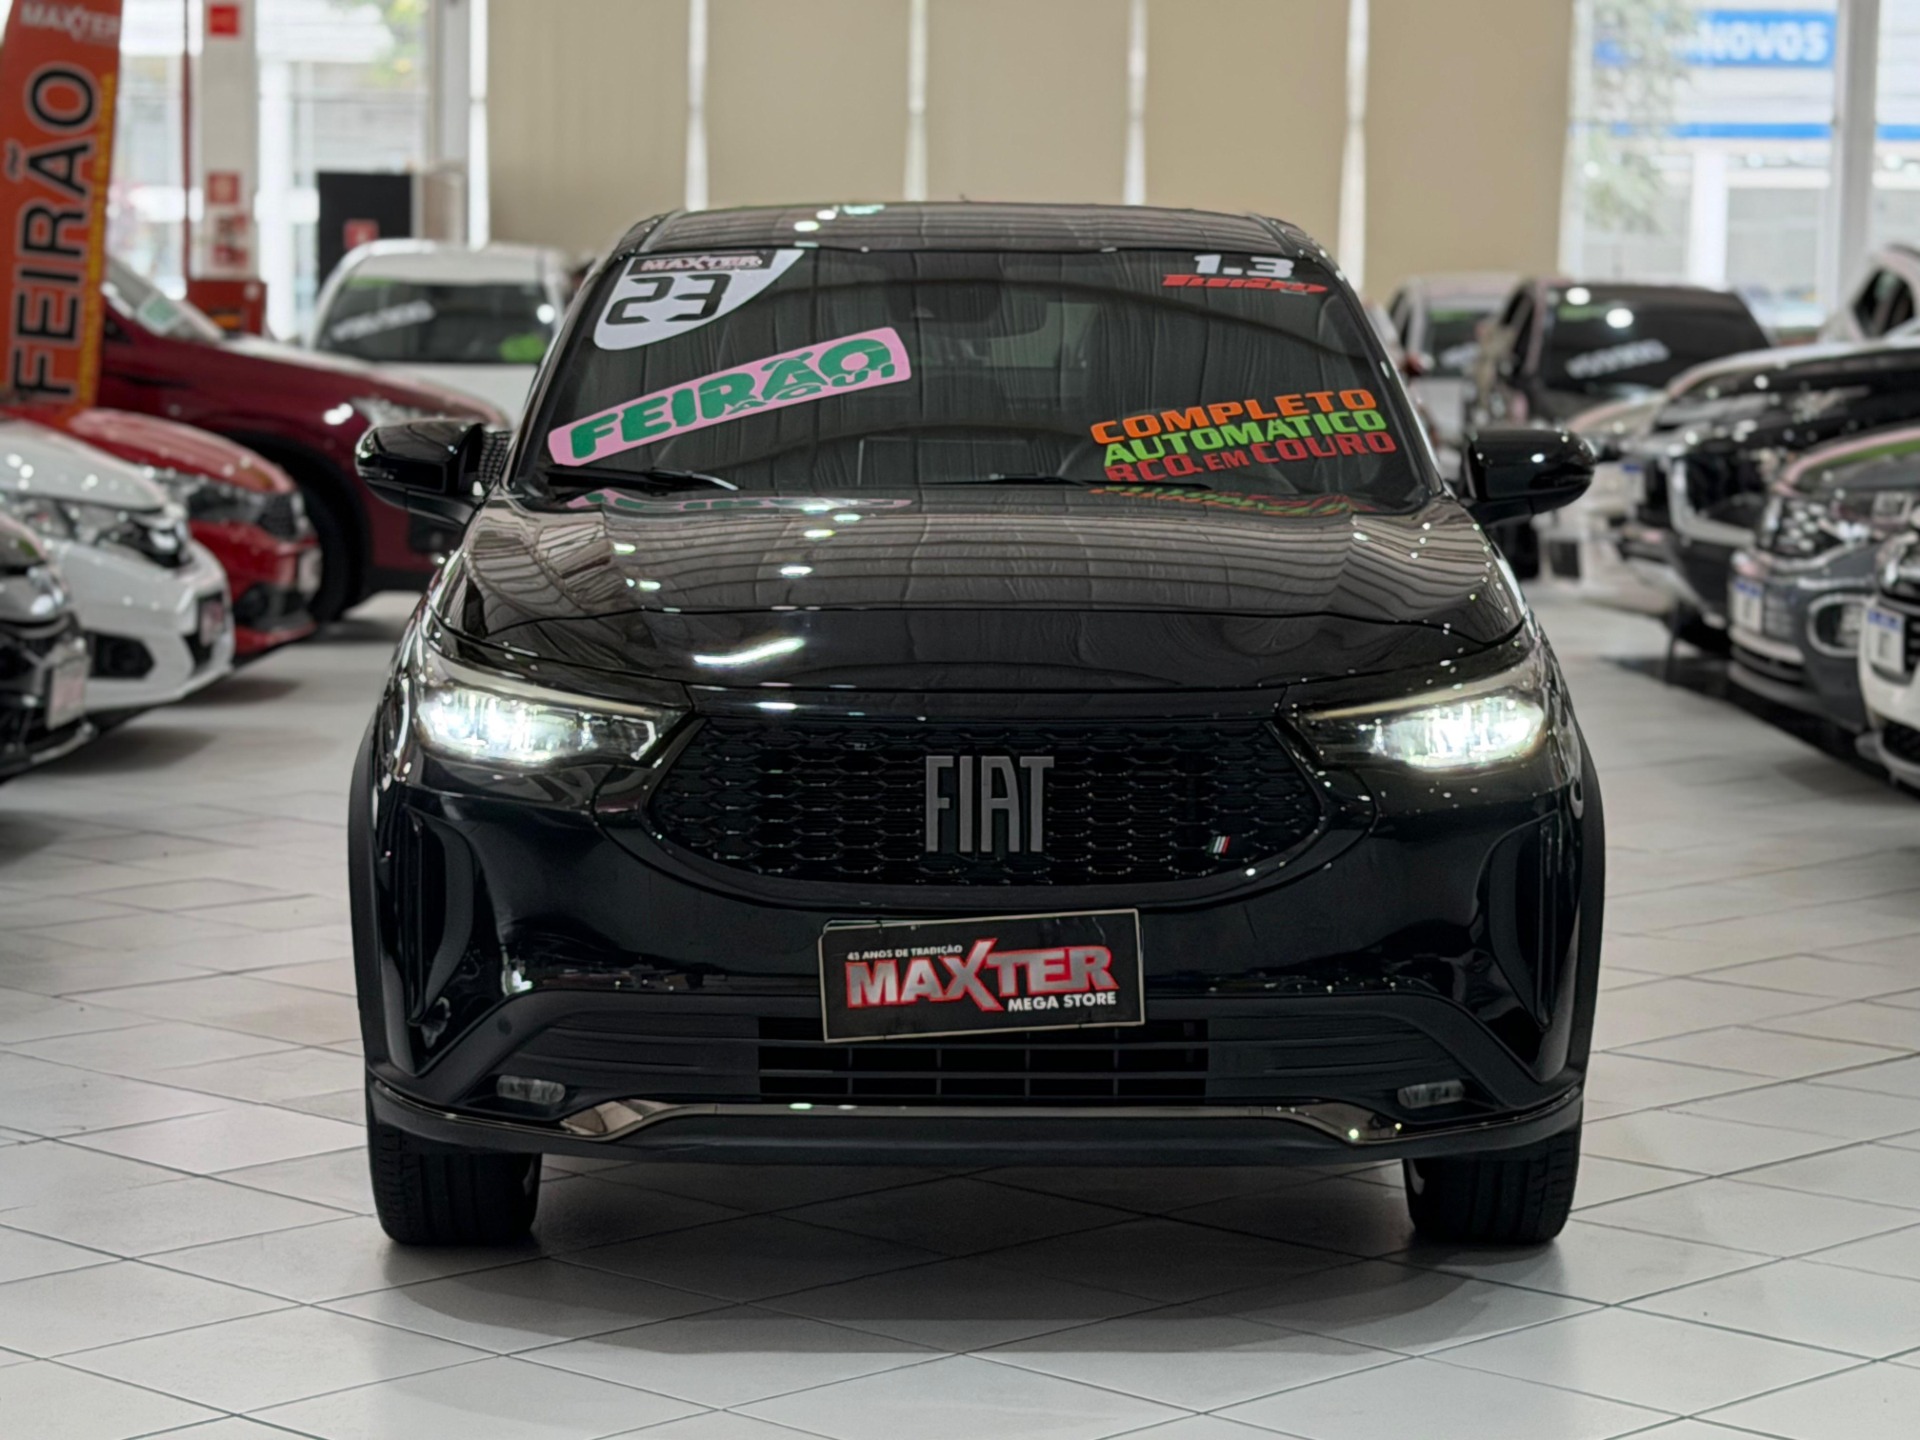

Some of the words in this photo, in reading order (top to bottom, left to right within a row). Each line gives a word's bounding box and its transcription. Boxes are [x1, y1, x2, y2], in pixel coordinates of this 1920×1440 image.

[7, 62, 97, 399] FEIRÃO
[641, 255, 763, 272] MAXTER
[1194, 254, 1295, 279] 1.3
[604, 273, 732, 326] 23
[570, 338, 893, 459] FEIRÃO
[1090, 388, 1377, 444] COMPLETO
[1203, 450, 1250, 471] EM
[1250, 431, 1397, 464] COURO
[926, 755, 1055, 852] FIAT
[845, 938, 1121, 1013] MAXTER
[862, 949, 893, 960] ANOS
[895, 948, 908, 958] DE
[910, 944, 964, 957] TRADIÇÃO
[1008, 998, 1060, 1012] MEGA
[1063, 991, 1117, 1009] STORE
